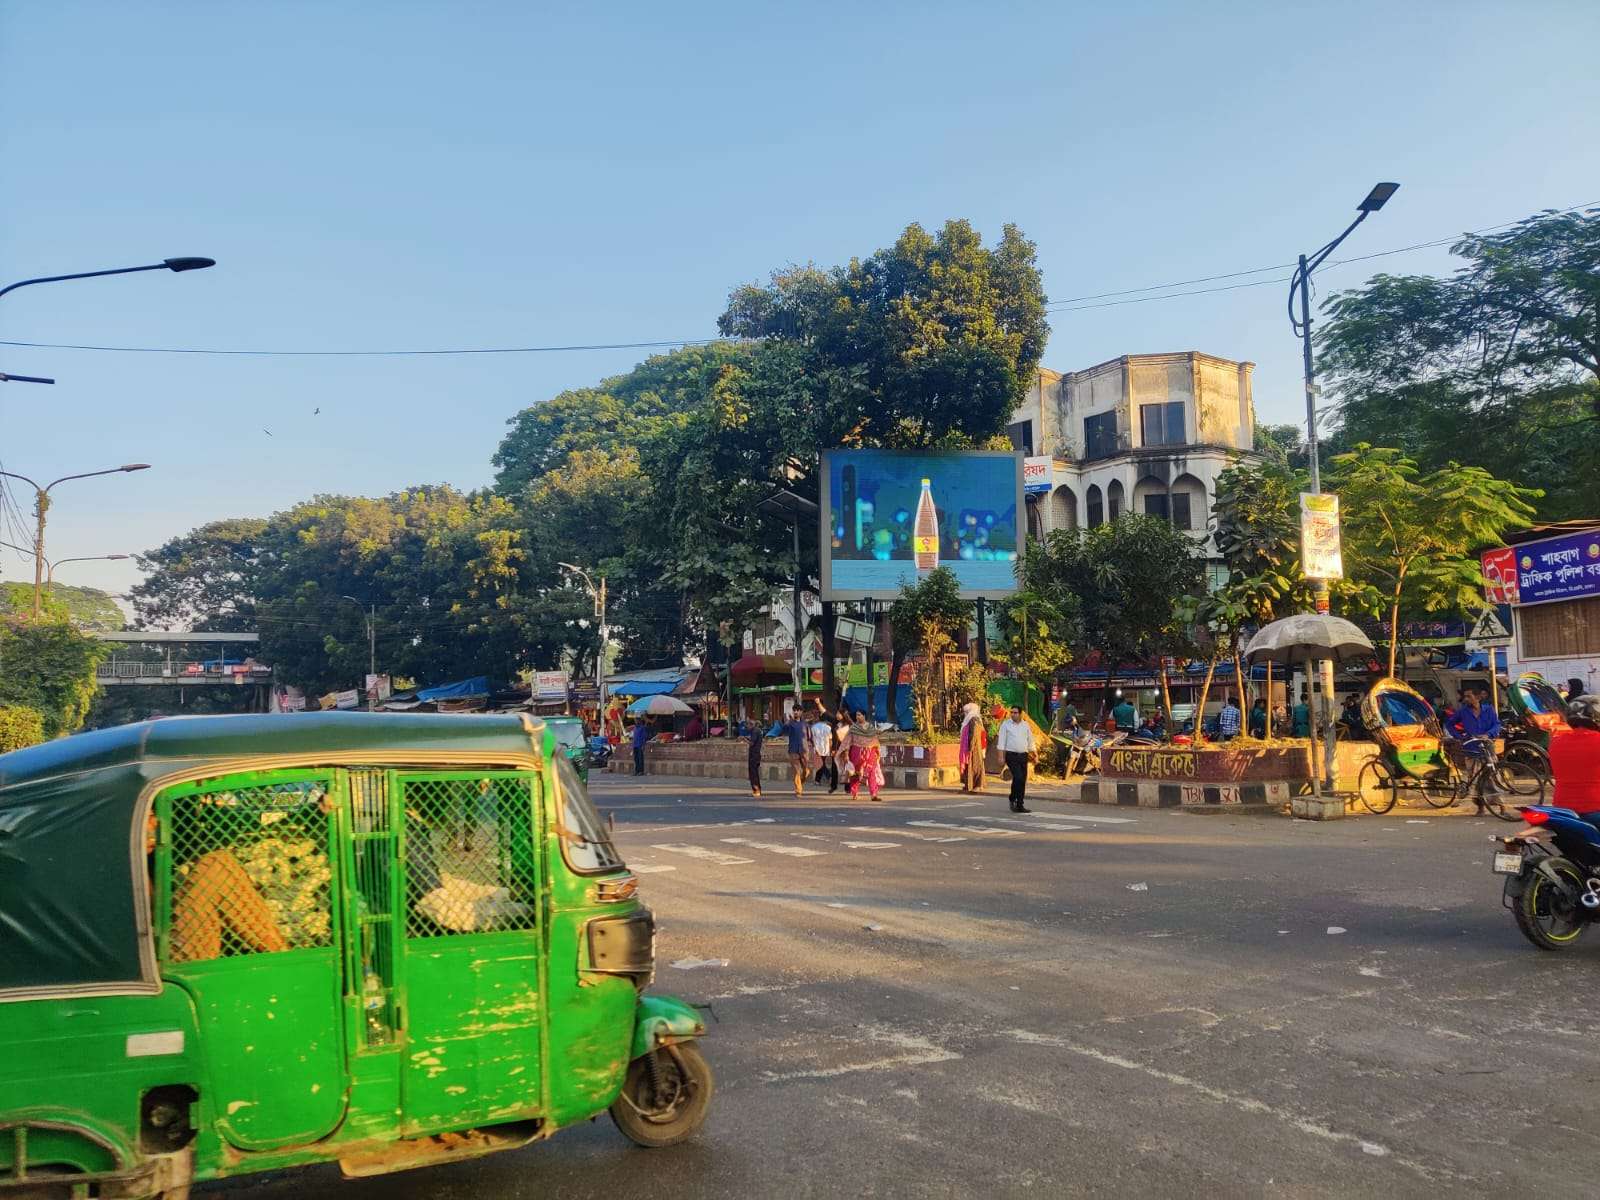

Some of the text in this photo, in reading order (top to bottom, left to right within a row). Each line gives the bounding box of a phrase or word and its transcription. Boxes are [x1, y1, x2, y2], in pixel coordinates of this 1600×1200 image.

[1540, 548, 1580, 565] শাহবাগ
[1520, 570, 1553, 588] ট্রাফিক
[1555, 564, 1585, 583] পুলিশ
[1111, 751, 1150, 774] বাংলা
